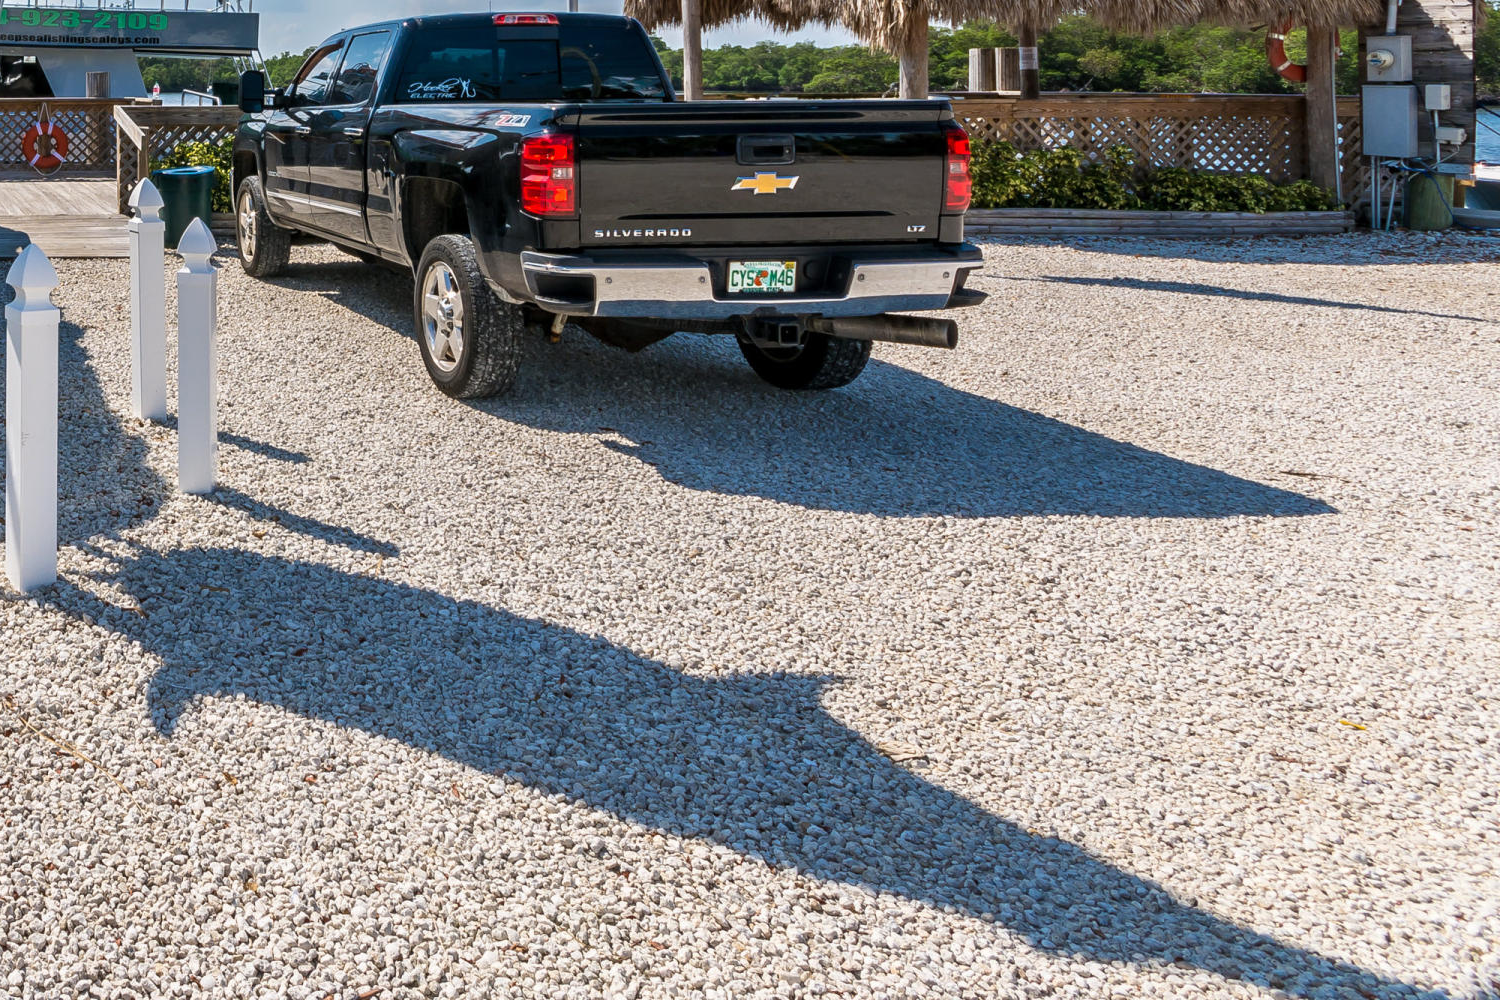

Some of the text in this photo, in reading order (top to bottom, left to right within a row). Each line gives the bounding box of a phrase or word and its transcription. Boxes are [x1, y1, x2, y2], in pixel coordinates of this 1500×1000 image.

[494, 114, 531, 127] Z71
[594, 228, 692, 238] SILVERADO
[907, 224, 926, 233] LTZ
[731, 269, 793, 287] CYS M46
